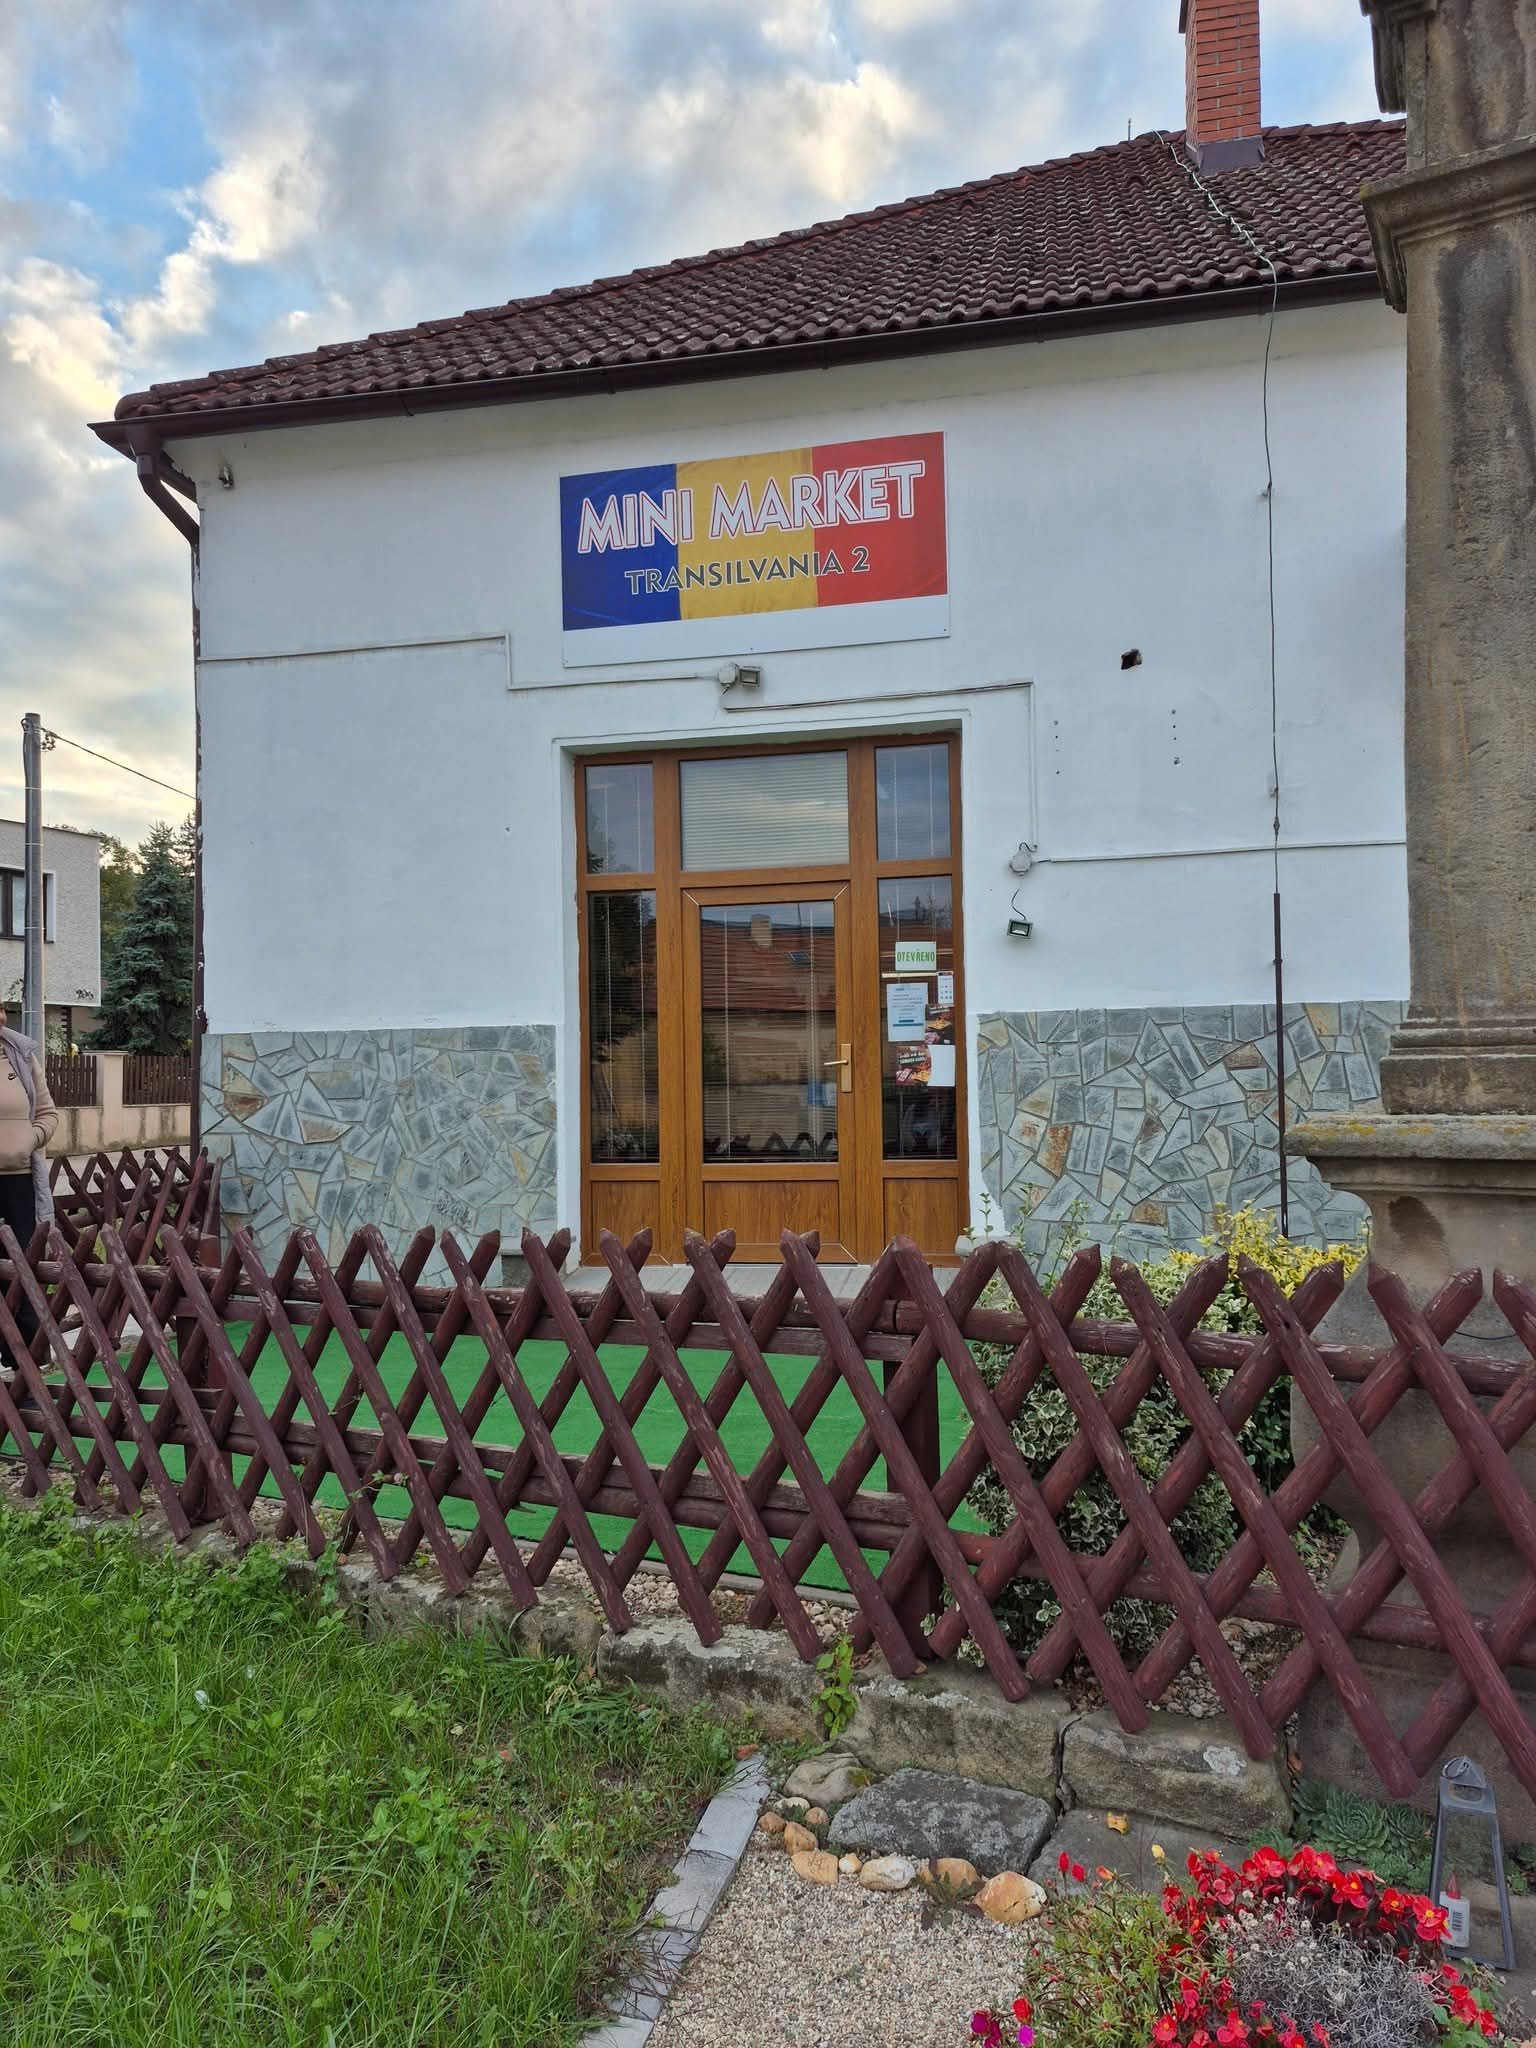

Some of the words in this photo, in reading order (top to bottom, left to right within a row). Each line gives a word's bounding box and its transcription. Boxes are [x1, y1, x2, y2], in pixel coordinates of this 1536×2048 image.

[577, 487, 694, 554] MINI
[709, 460, 926, 539] MARKET
[625, 549, 843, 595] TRANSILVANIA
[850, 545, 870, 573] 2
